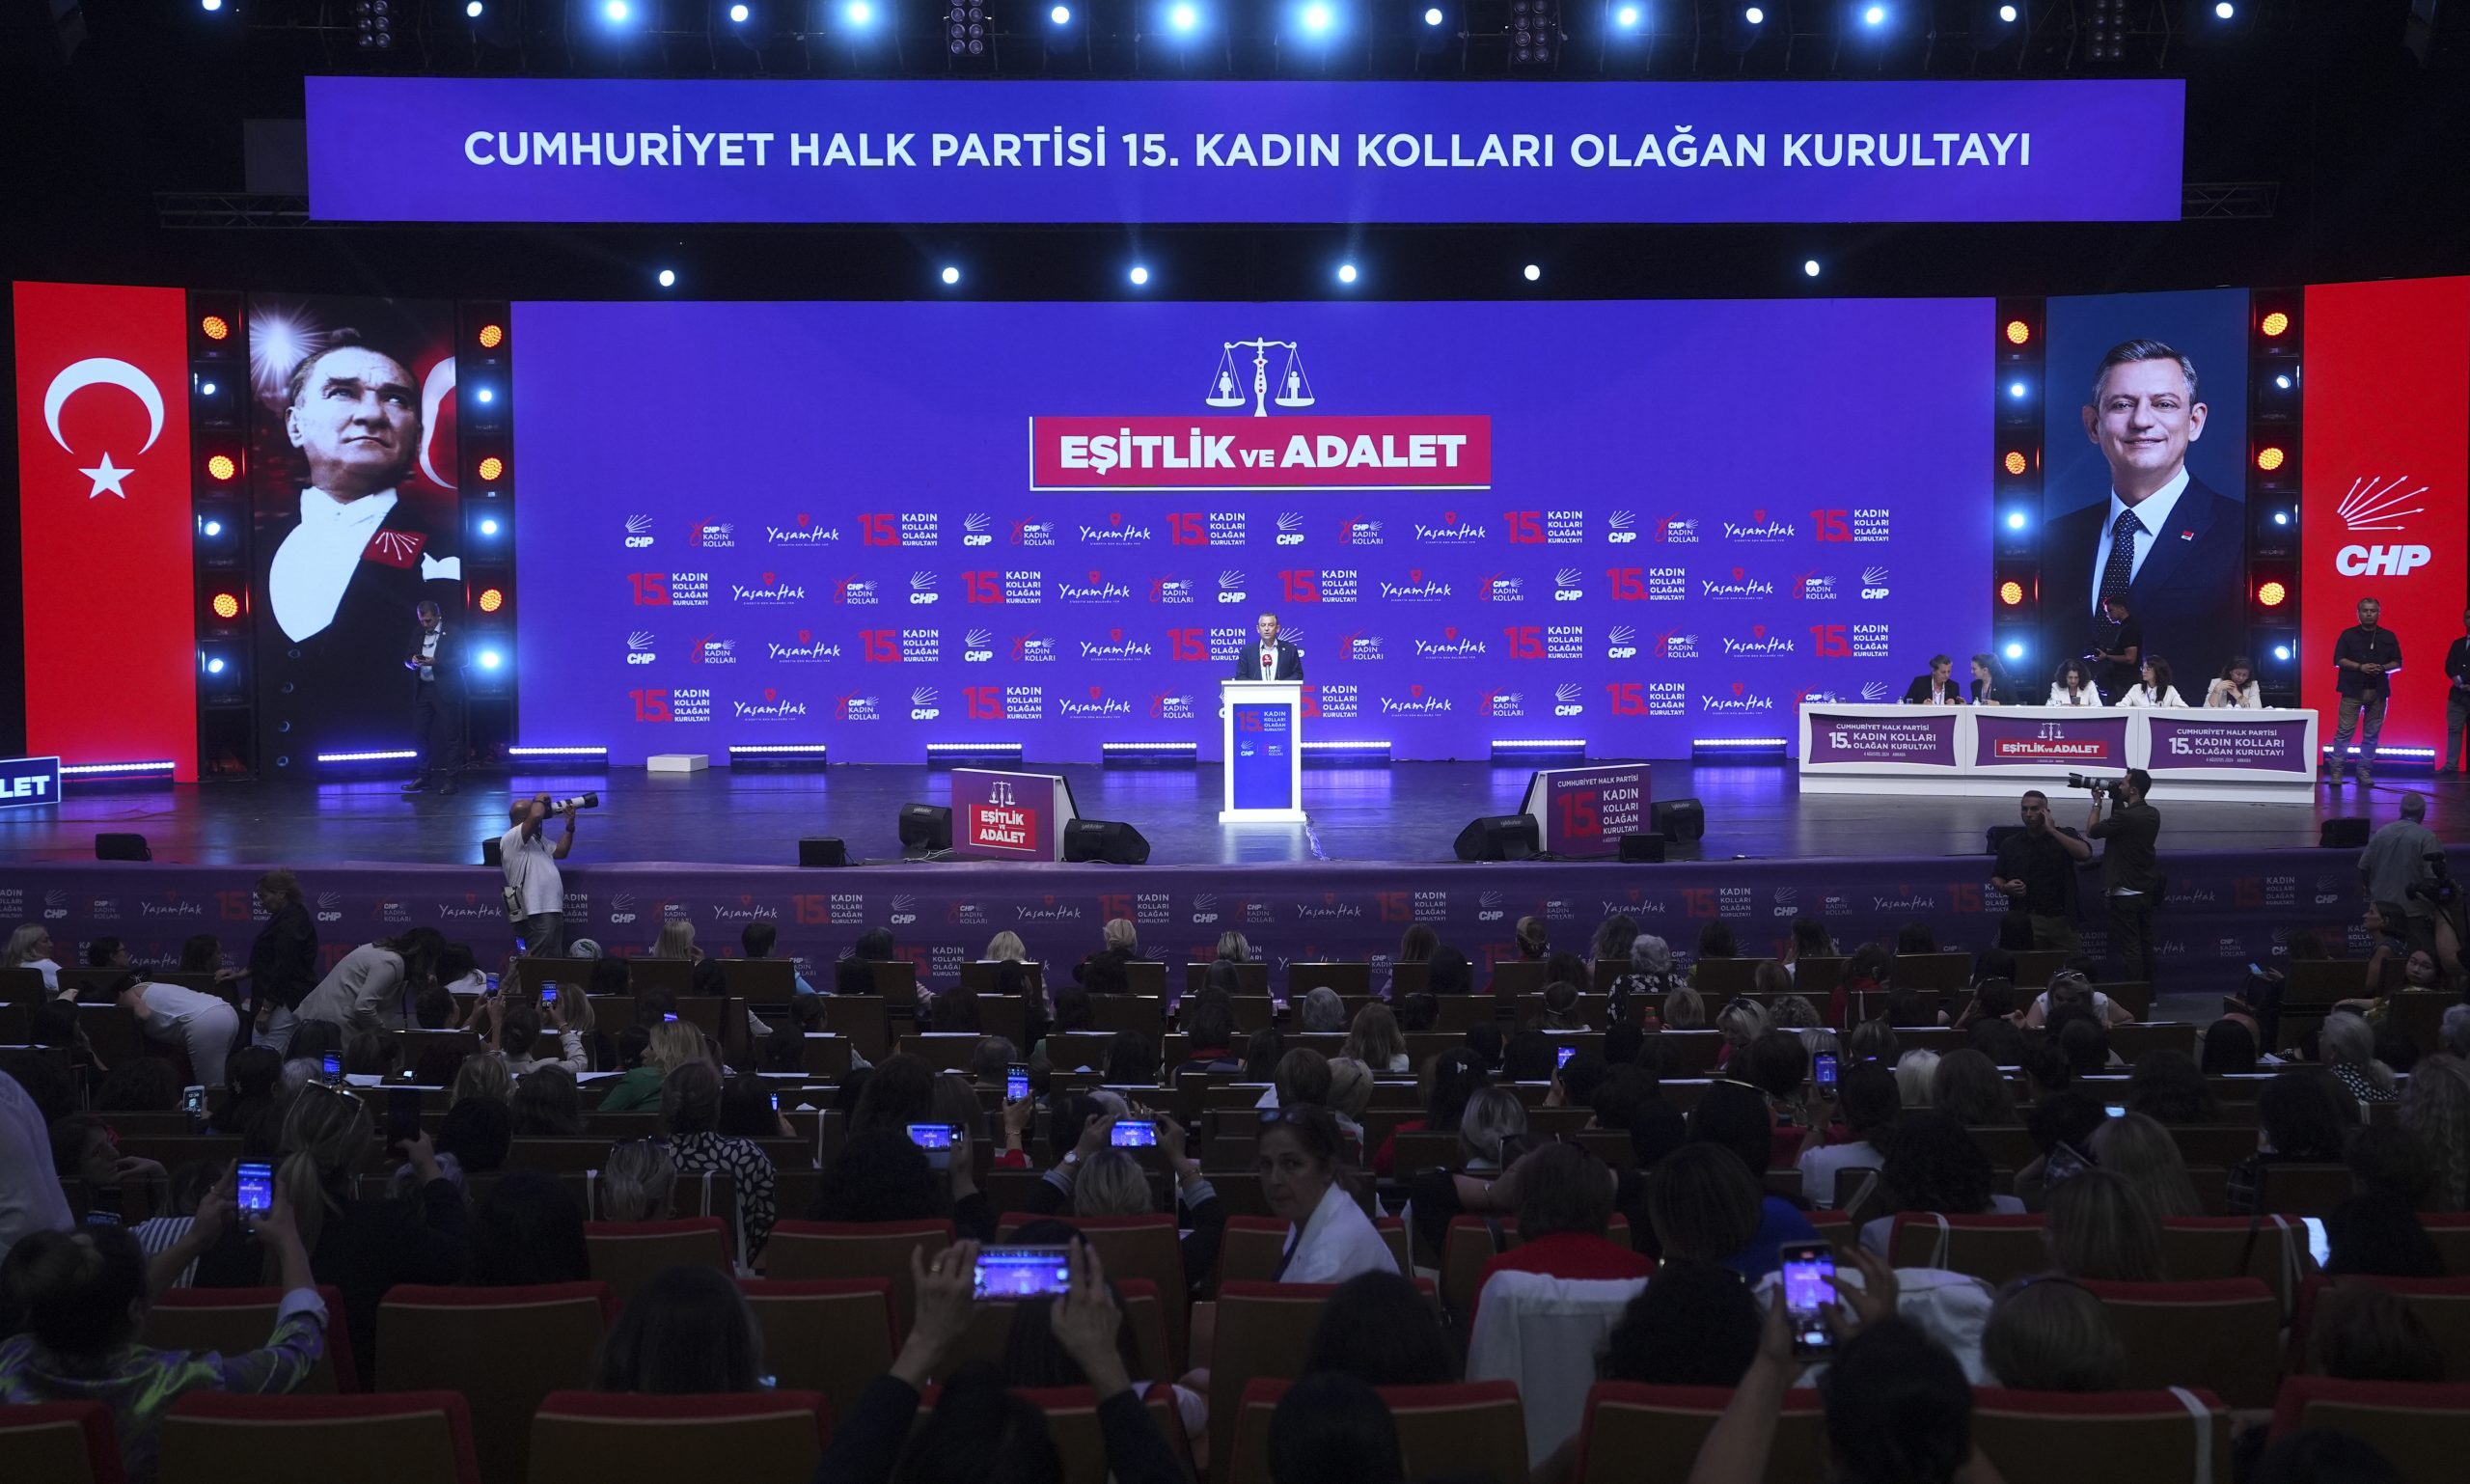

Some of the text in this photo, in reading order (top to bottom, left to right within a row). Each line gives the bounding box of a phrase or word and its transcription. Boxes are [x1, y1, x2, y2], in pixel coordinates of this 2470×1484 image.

[465, 124, 2029, 167] CUMHURİYET HALK PARTİSİ 15. KADIN KOLLARI OLAĞAN KURULTAYI
[1060, 427, 1467, 475] EŞİTLİK VE ADALET
[902, 513, 938, 522] KADIN
[1210, 512, 1245, 521] KADIN
[1548, 510, 1582, 519] KADIN
[857, 513, 901, 547] 15.
[1166, 512, 1210, 546] 15.
[1503, 510, 1547, 544] 15.
[1810, 509, 1853, 542] 15.
[625, 536, 654, 548] CHP
[964, 535, 992, 546] CHP
[1276, 534, 1304, 545] CHP
[1608, 532, 1636, 543] CHP
[2336, 545, 2431, 576] CHP
[672, 573, 708, 582] KADIN
[1005, 571, 1041, 580] KADIN
[627, 572, 672, 606] 15.
[961, 570, 1005, 604] 15.
[1606, 567, 1649, 601] 15.
[910, 592, 939, 604] CHP
[1554, 590, 1582, 601] CHP
[1861, 589, 1889, 599] CHP
[964, 650, 993, 662] CHP
[1608, 647, 1636, 658] CHP
[627, 653, 656, 665] CHP
[1650, 683, 1685, 692] KADIN
[674, 689, 710, 698] KADIN
[1606, 682, 1649, 716] 15.
[629, 689, 672, 723] 15.
[674, 706, 710, 715] OLAĞAN
[1554, 704, 1583, 716] CHP
[911, 708, 940, 720] CHP
[1828, 732, 1852, 749] 15.
[1853, 732, 1886, 741] KADIN
[2002, 742, 2045, 754] EŞİTLİK
[2051, 745, 2100, 754] ADALET
[2169, 737, 2193, 755] 15.
[2236, 738, 2284, 747] KOLLARI
[1557, 778, 1597, 787] CUMHURİYET
[1616, 774, 1638, 783] PARTİSİ
[1604, 787, 1638, 801] KADIN
[1604, 802, 1638, 812] KOLLARI
[980, 809, 1024, 826] EŞİTLİK
[1603, 813, 1638, 825] OLAĞAN
[1604, 825, 1638, 835] KURULTAYI
[979, 828, 1026, 844] ADALET
[2315, 894, 2338, 904] CHP
[43, 909, 68, 919] CHP
[317, 912, 342, 921] CHP
[1478, 911, 1503, 921] CHP
[1773, 907, 1798, 917] CHP
[611, 914, 636, 923] CHP
[891, 914, 916, 923] CHP
[1193, 914, 1218, 923] CHP
